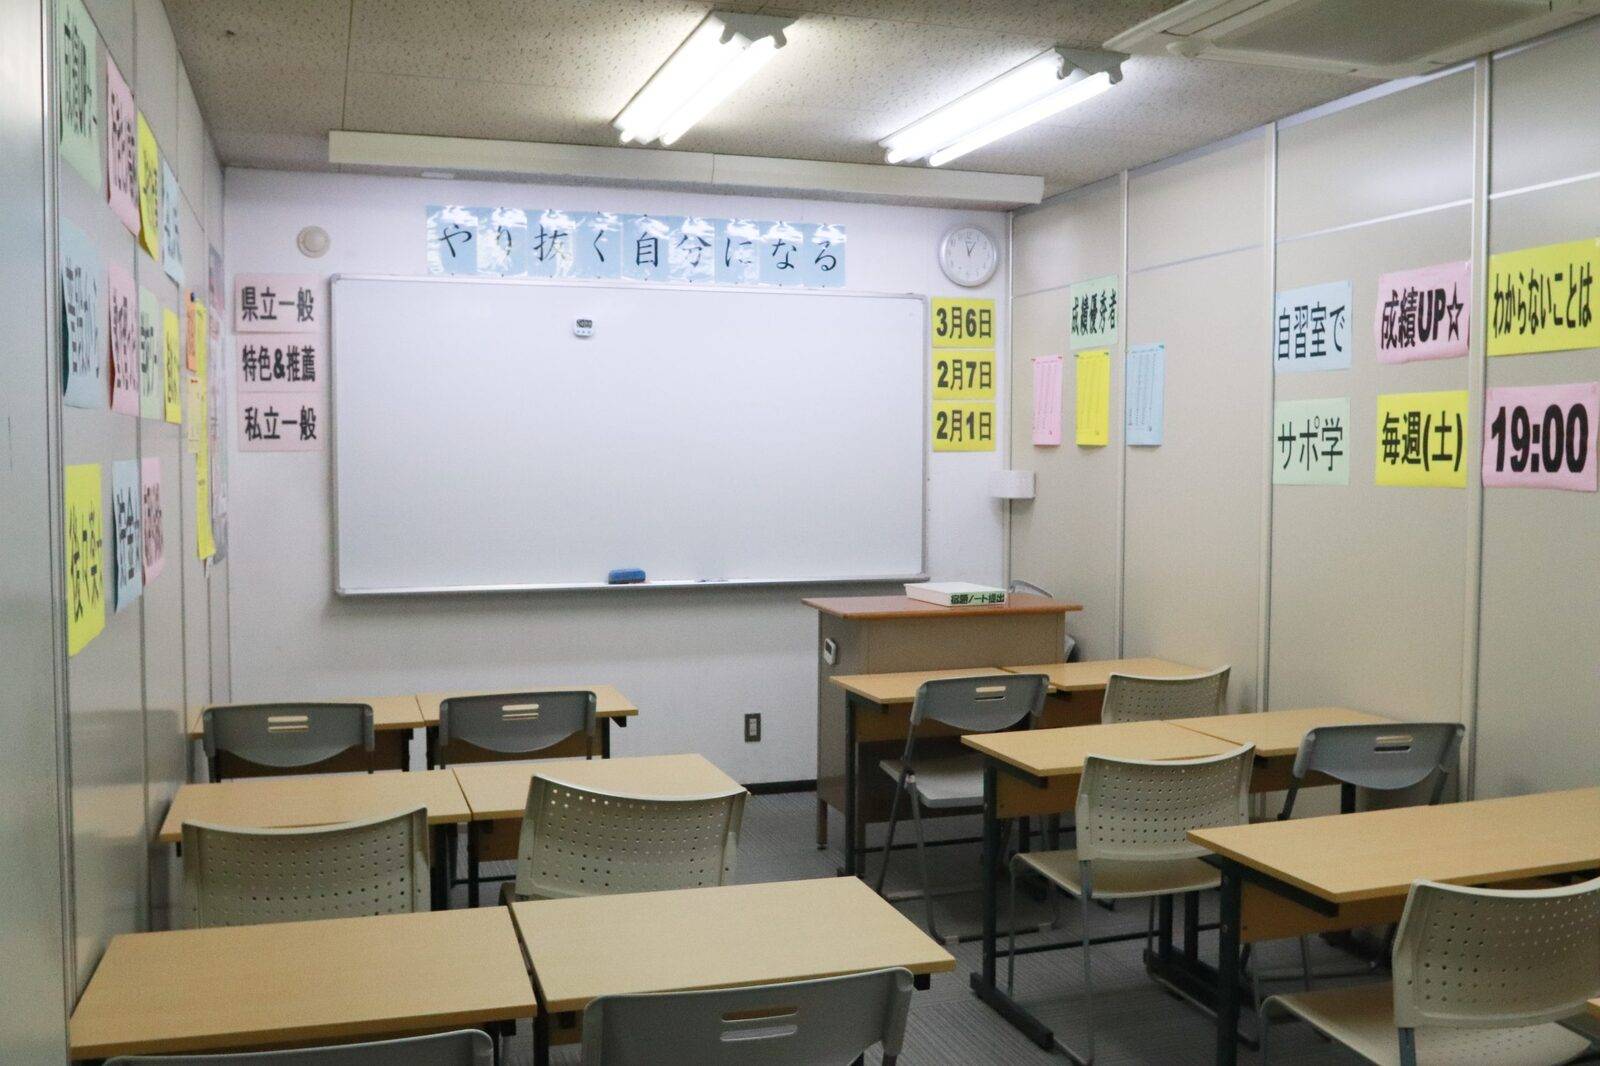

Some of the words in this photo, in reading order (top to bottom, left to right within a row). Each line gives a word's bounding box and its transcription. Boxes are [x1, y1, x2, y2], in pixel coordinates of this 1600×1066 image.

[440, 224, 837, 272] やり抜く自分になる
[242, 286, 314, 322] 県立一般
[1493, 262, 1593, 338] わからないことは
[936, 307, 991, 339] 3月6日
[1278, 301, 1346, 361] 自習室で
[242, 345, 315, 382] 特色&推薦
[937, 359, 992, 391] 2月7日
[245, 405, 316, 441] 私立一般
[936, 410, 991, 442] 2月1日
[1278, 416, 1343, 472] サポ学
[1382, 410, 1463, 472] 毎週(土)
[1491, 403, 1589, 473] 19:00
